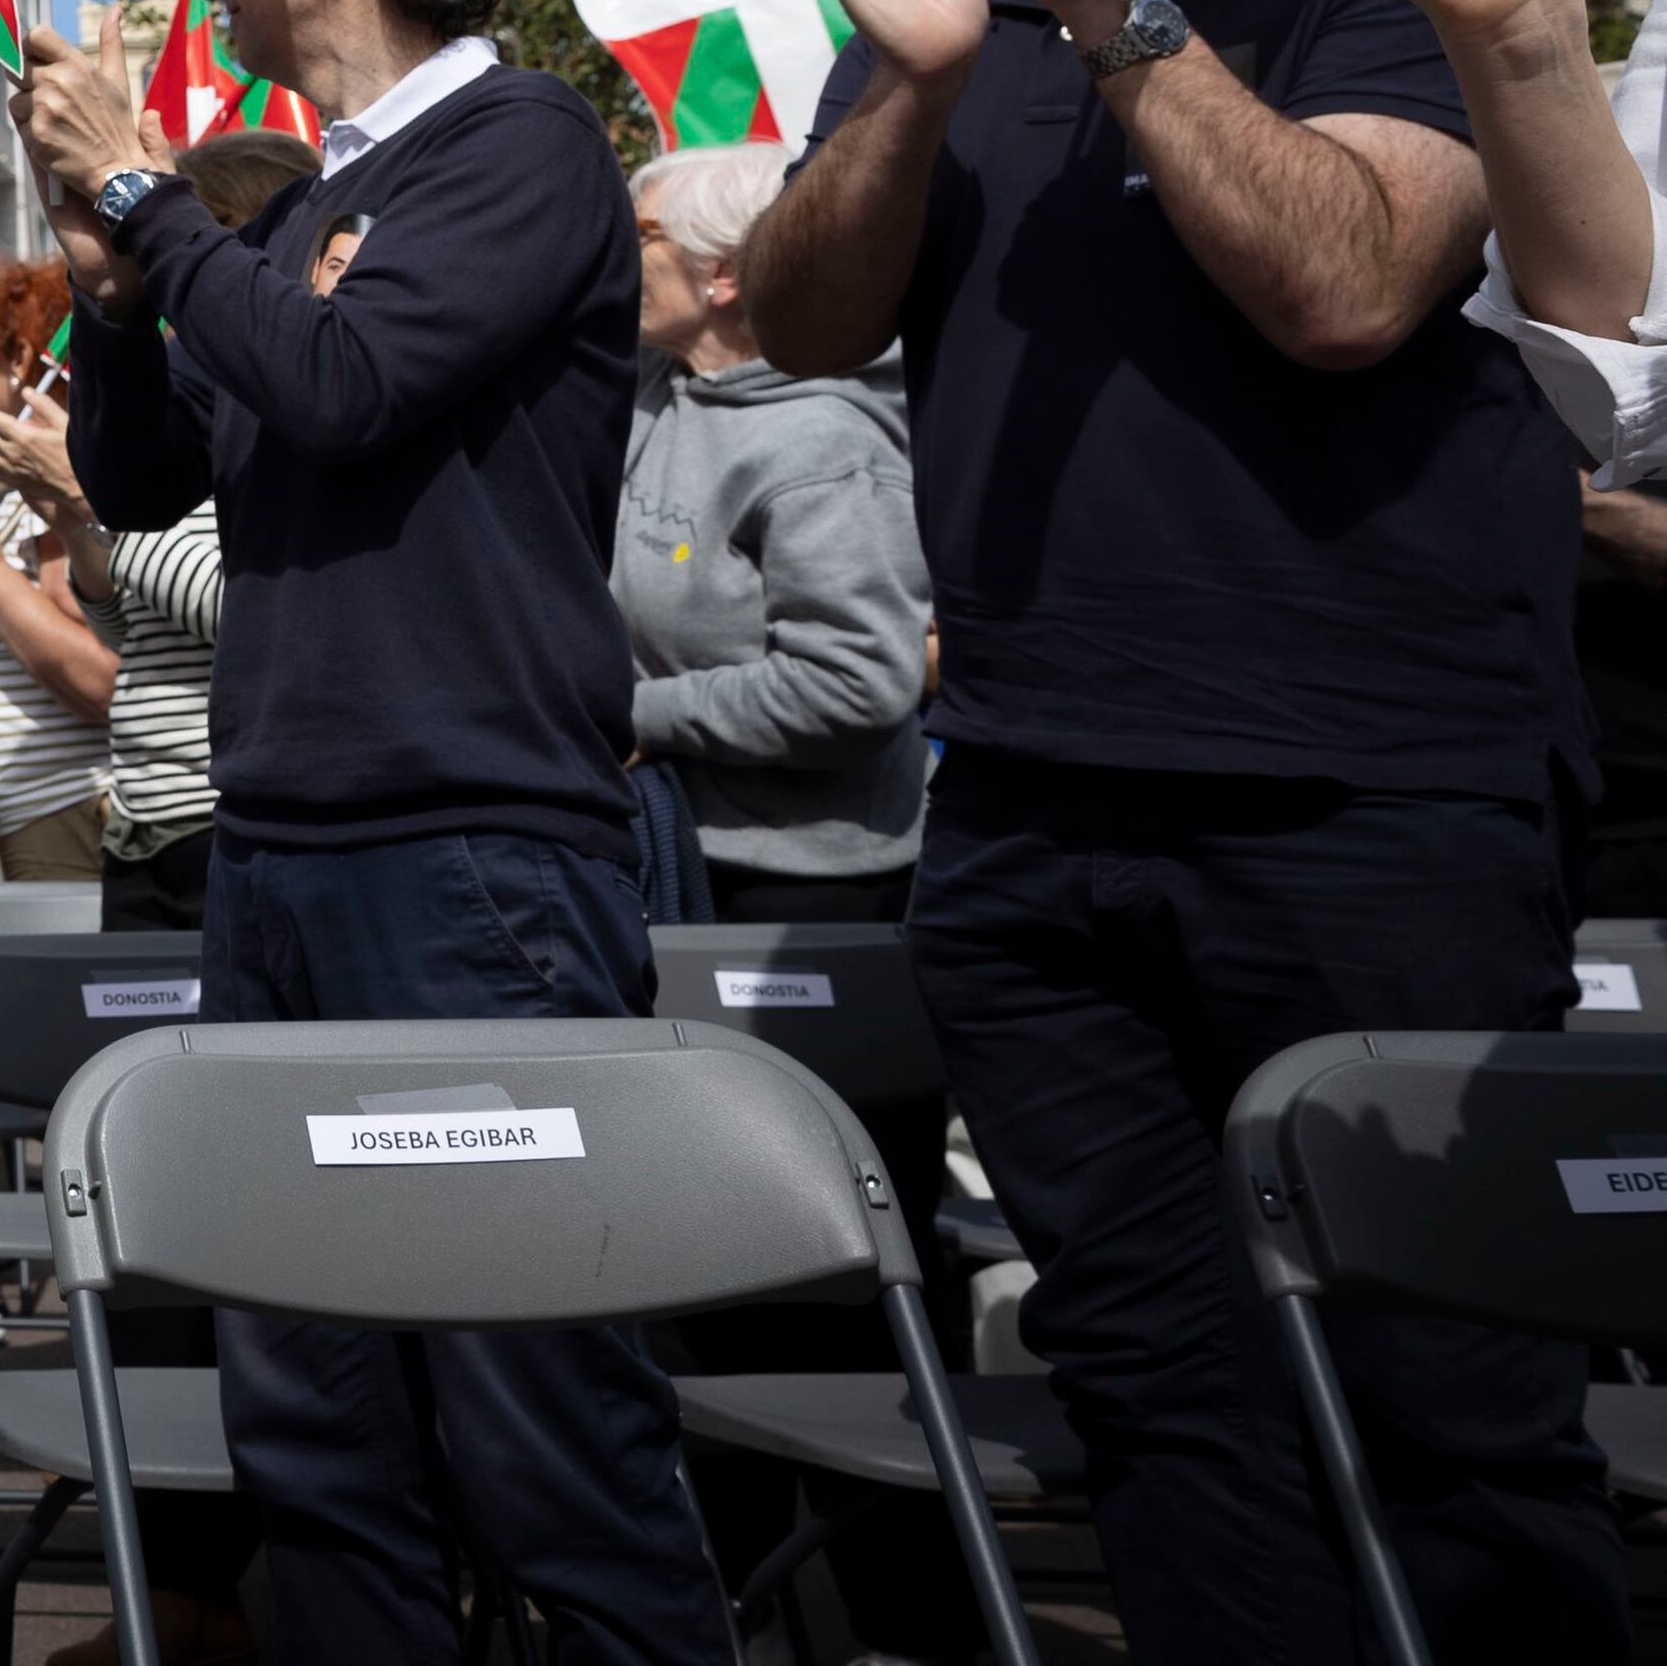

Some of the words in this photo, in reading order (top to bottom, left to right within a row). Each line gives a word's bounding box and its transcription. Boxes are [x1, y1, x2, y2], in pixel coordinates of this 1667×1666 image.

[730, 983, 811, 998] DONOSTIA
[102, 991, 182, 1006] DONOSTIA
[351, 1131, 441, 1150] JOSEBA
[446, 1127, 538, 1148] EGIBAR
